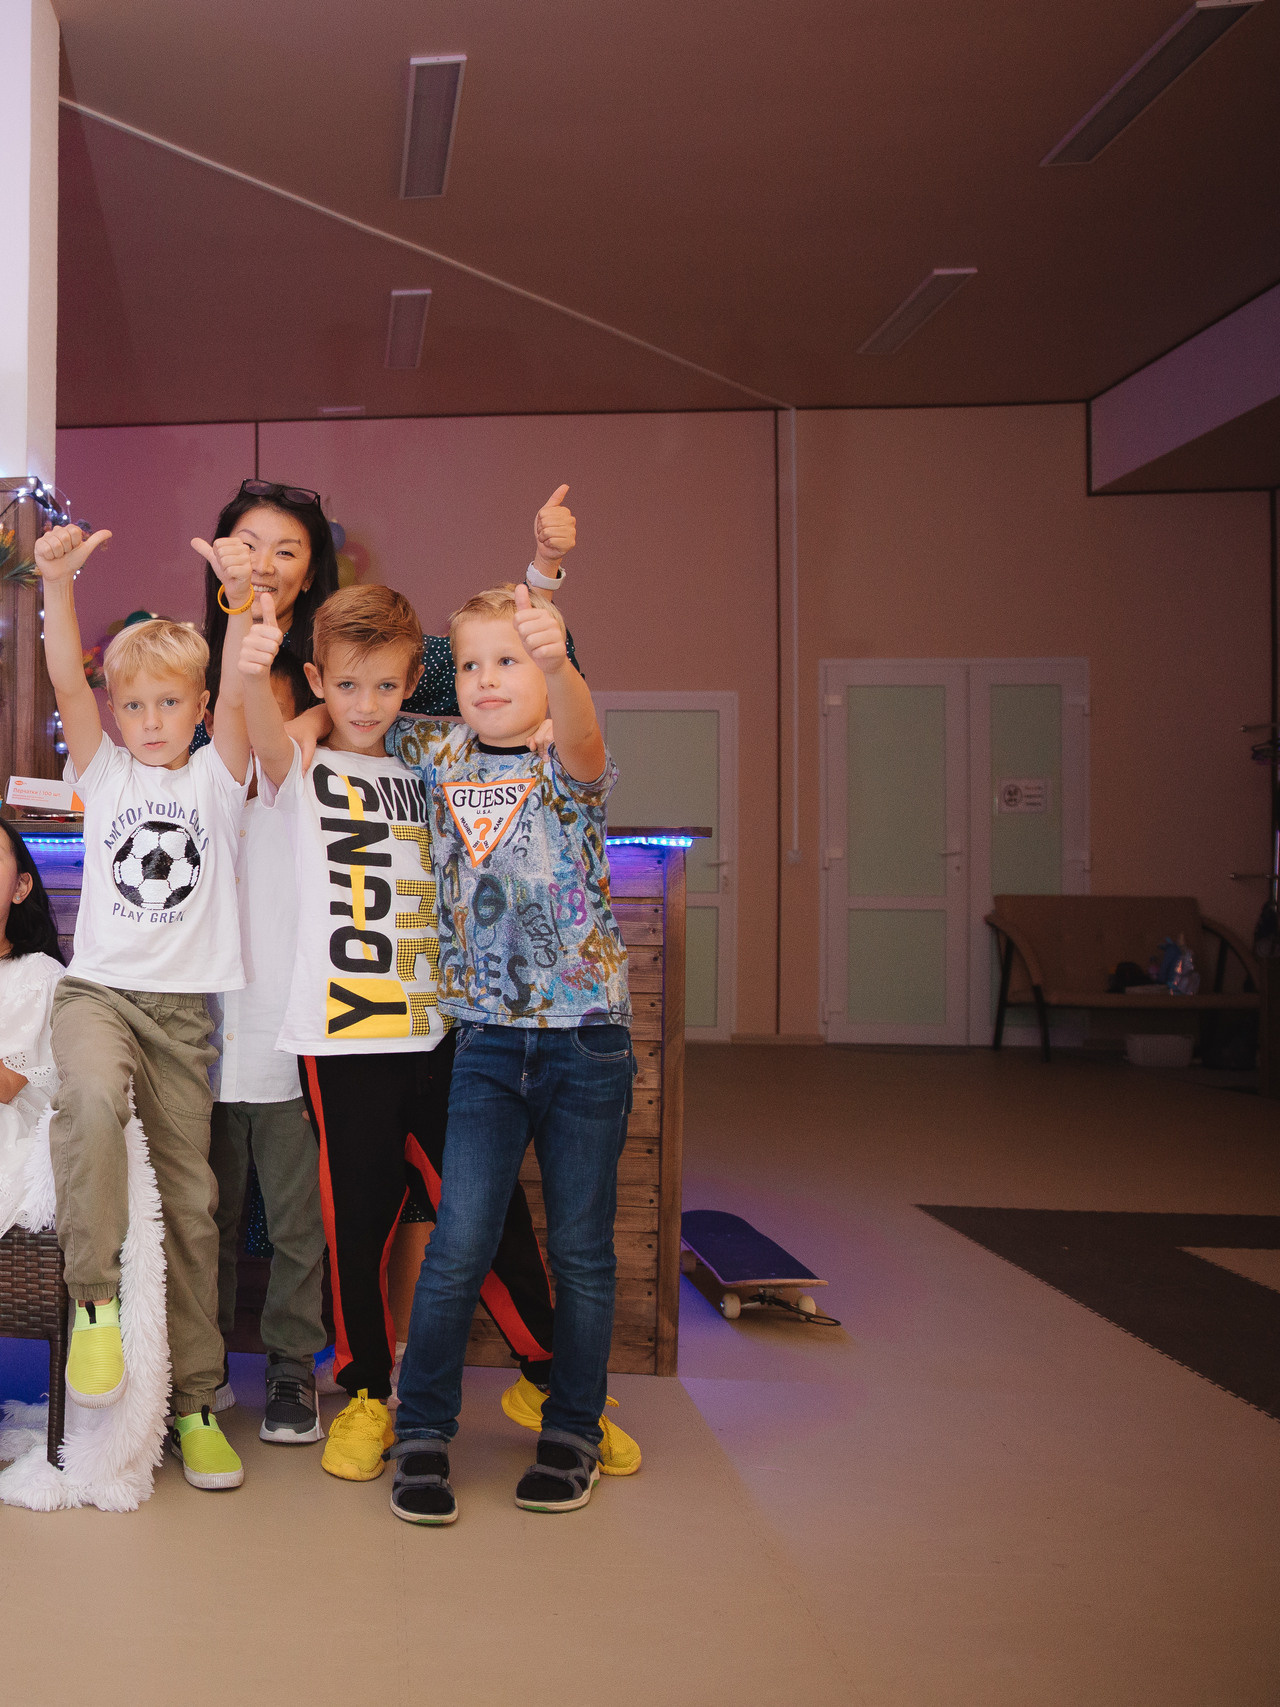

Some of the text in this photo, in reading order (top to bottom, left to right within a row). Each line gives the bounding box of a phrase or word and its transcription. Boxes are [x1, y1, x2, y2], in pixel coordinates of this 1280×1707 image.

[452, 786, 518, 808] GUESS
[460, 816, 473, 835] WASHED
[493, 817, 504, 832] JEANS
[313, 763, 407, 1035] YOUNG
[112, 902, 144, 923] PLAY
